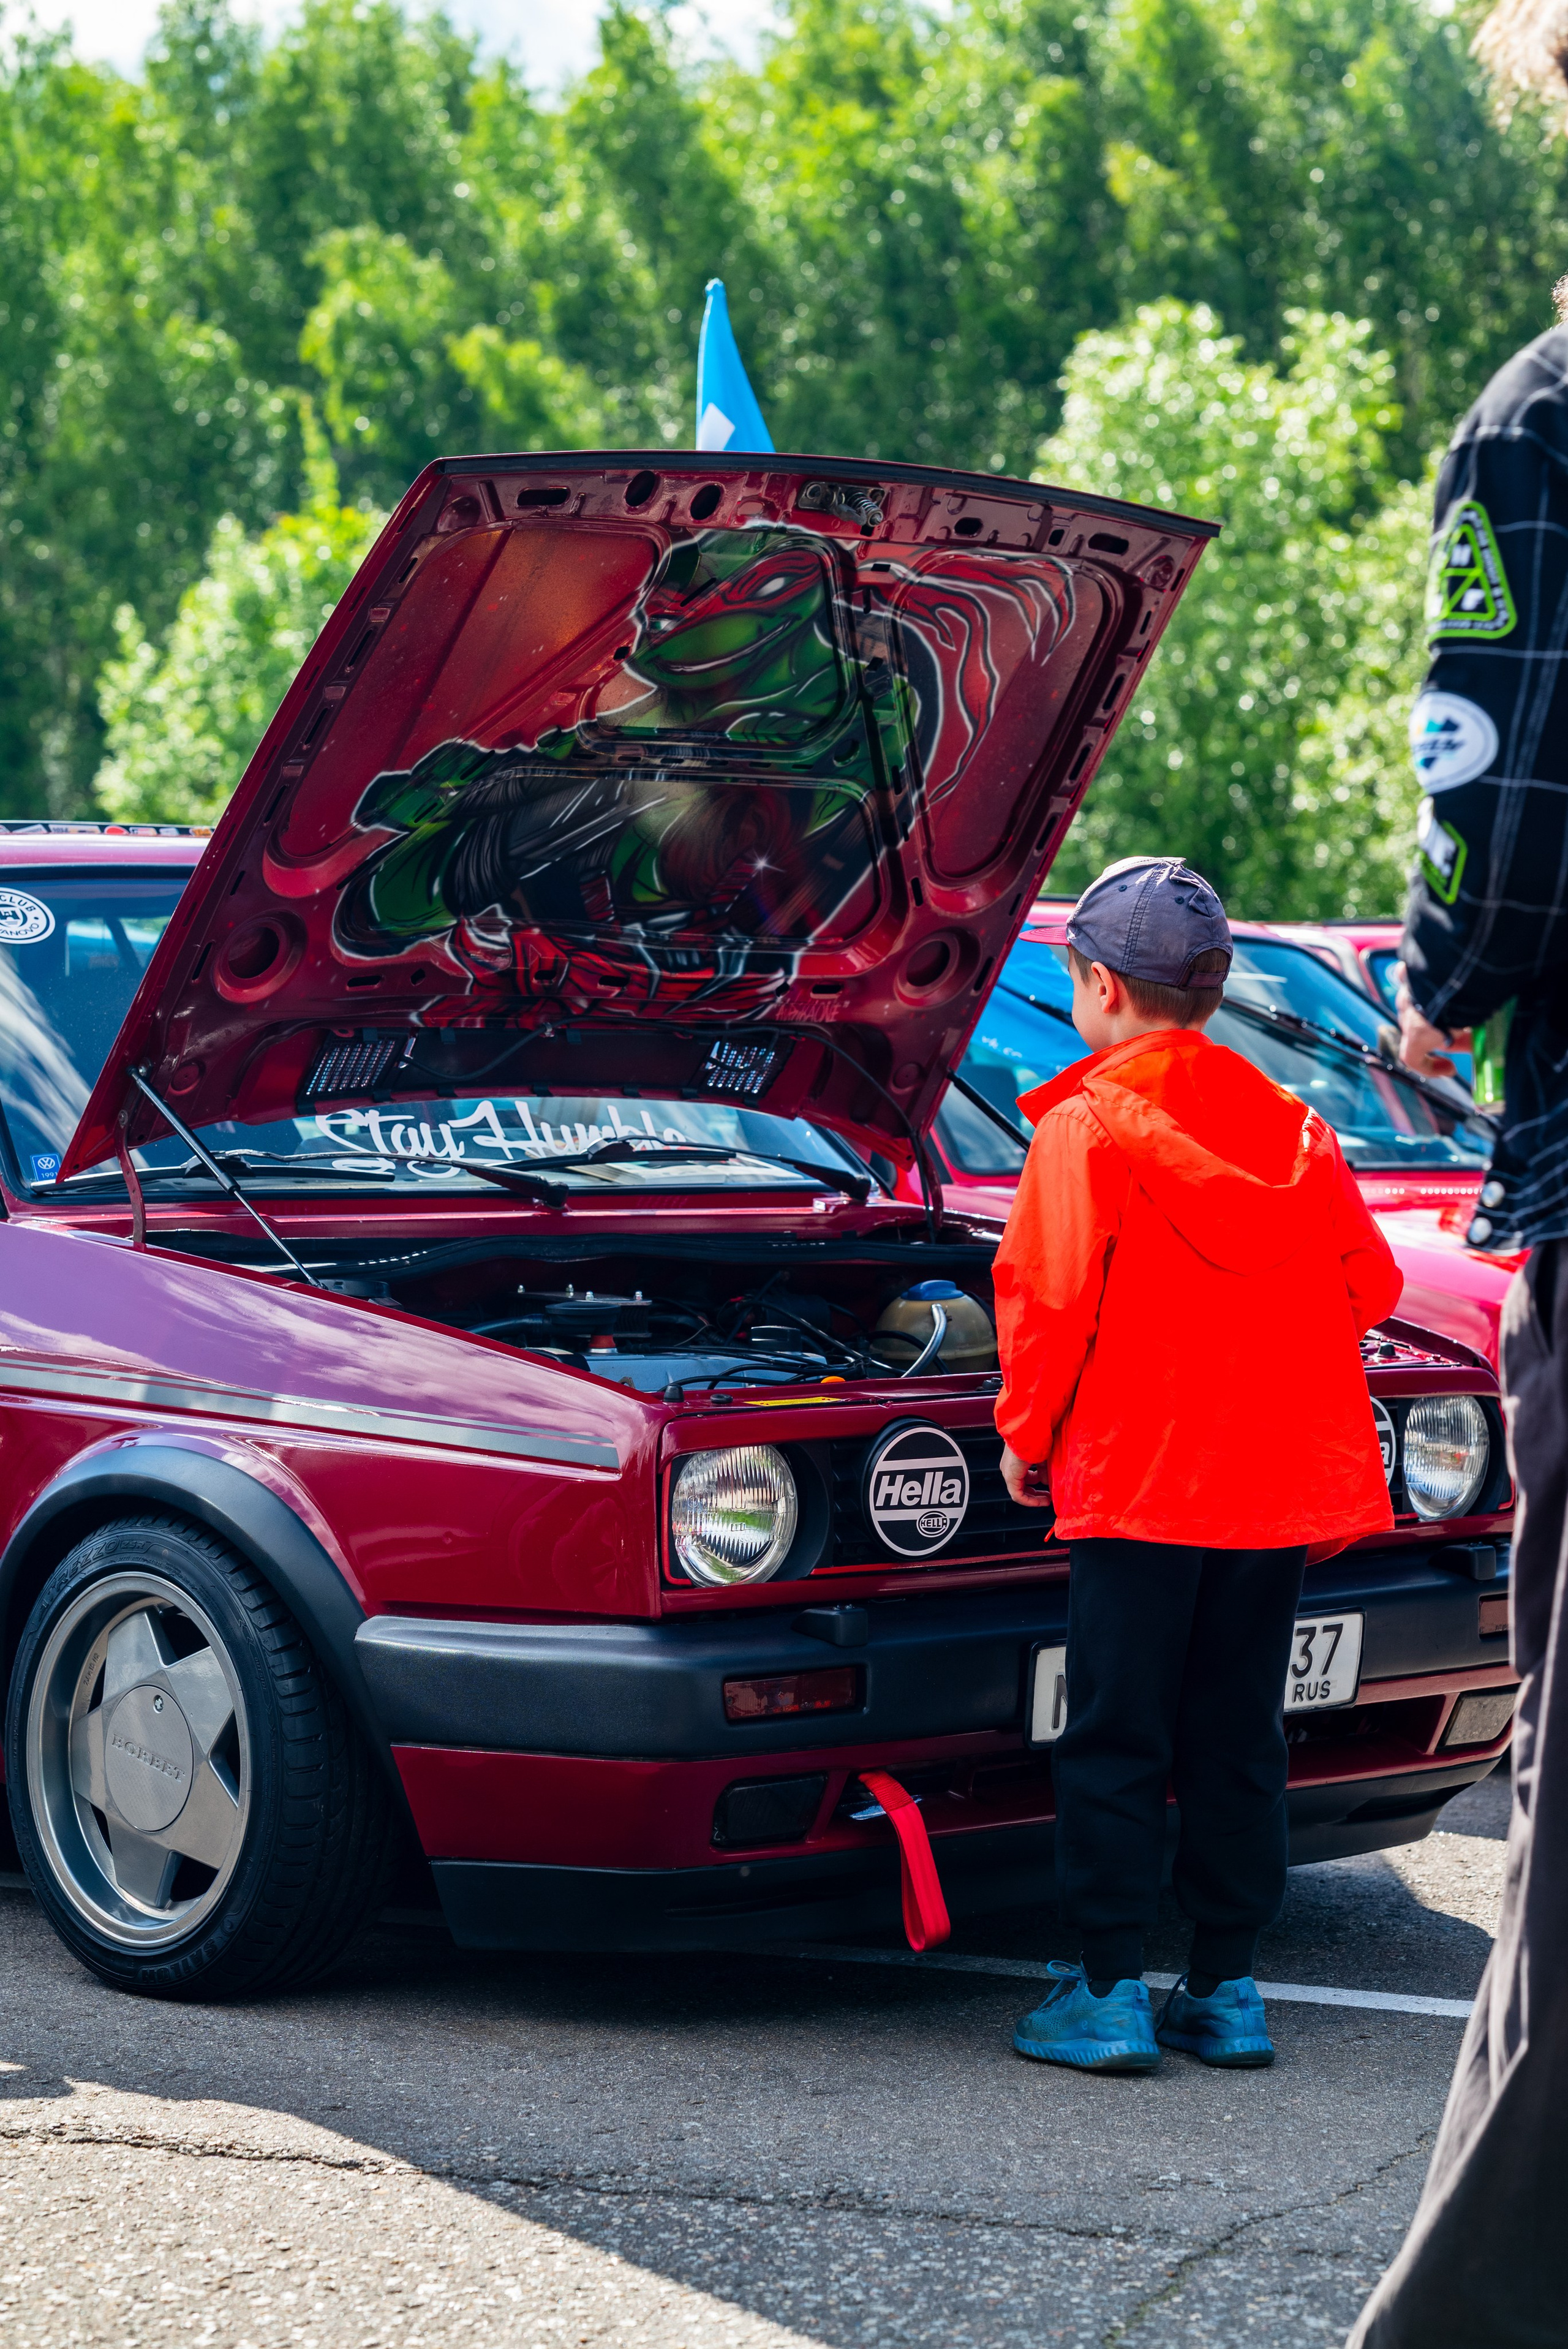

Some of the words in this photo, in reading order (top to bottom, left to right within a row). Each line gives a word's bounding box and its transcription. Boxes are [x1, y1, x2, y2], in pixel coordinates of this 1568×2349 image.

[0, 894, 36, 911] CLUB
[0, 922, 39, 935] ANOVO
[315, 1109, 464, 1178] Stay
[875, 1471, 962, 1506] Hella
[921, 1517, 948, 1528] HELLA
[1291, 1623, 1343, 1678] 37
[1293, 1680, 1331, 1703] RUS
[111, 1733, 186, 1783] BORBET
